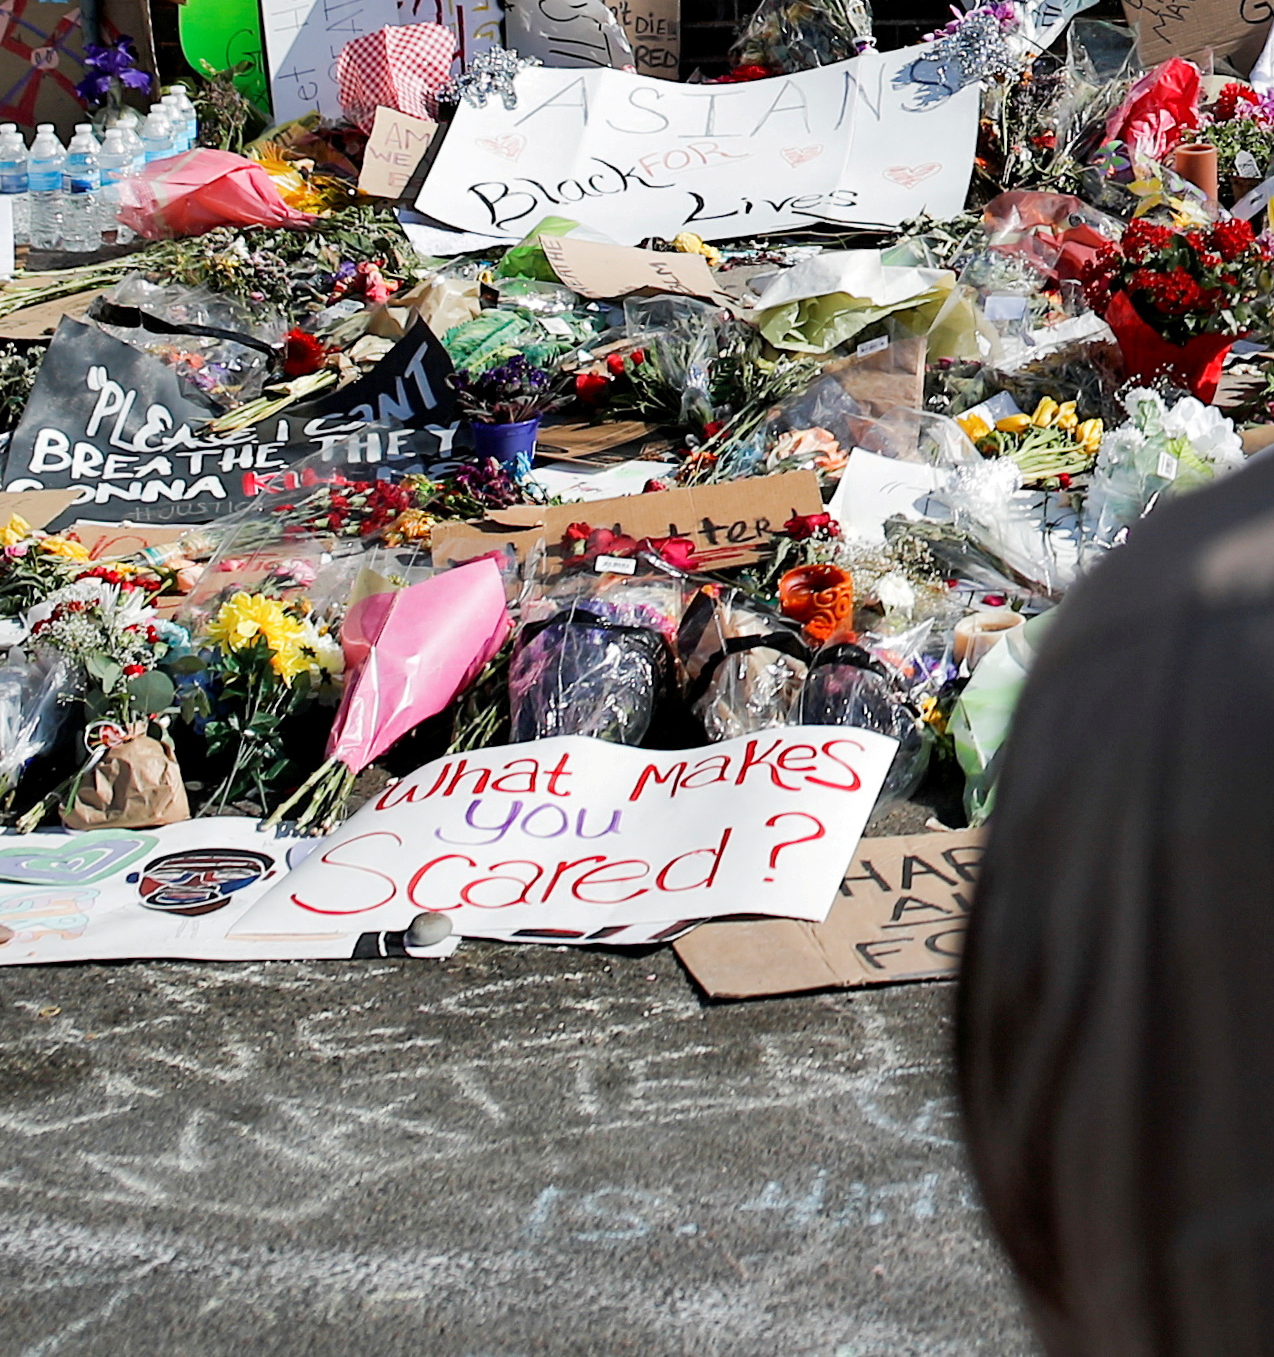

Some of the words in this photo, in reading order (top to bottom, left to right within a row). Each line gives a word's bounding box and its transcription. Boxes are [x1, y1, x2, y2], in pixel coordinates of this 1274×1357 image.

[468, 157, 676, 230] Black
[682, 186, 860, 227] Lives
[309, 420, 462, 464] THEY
